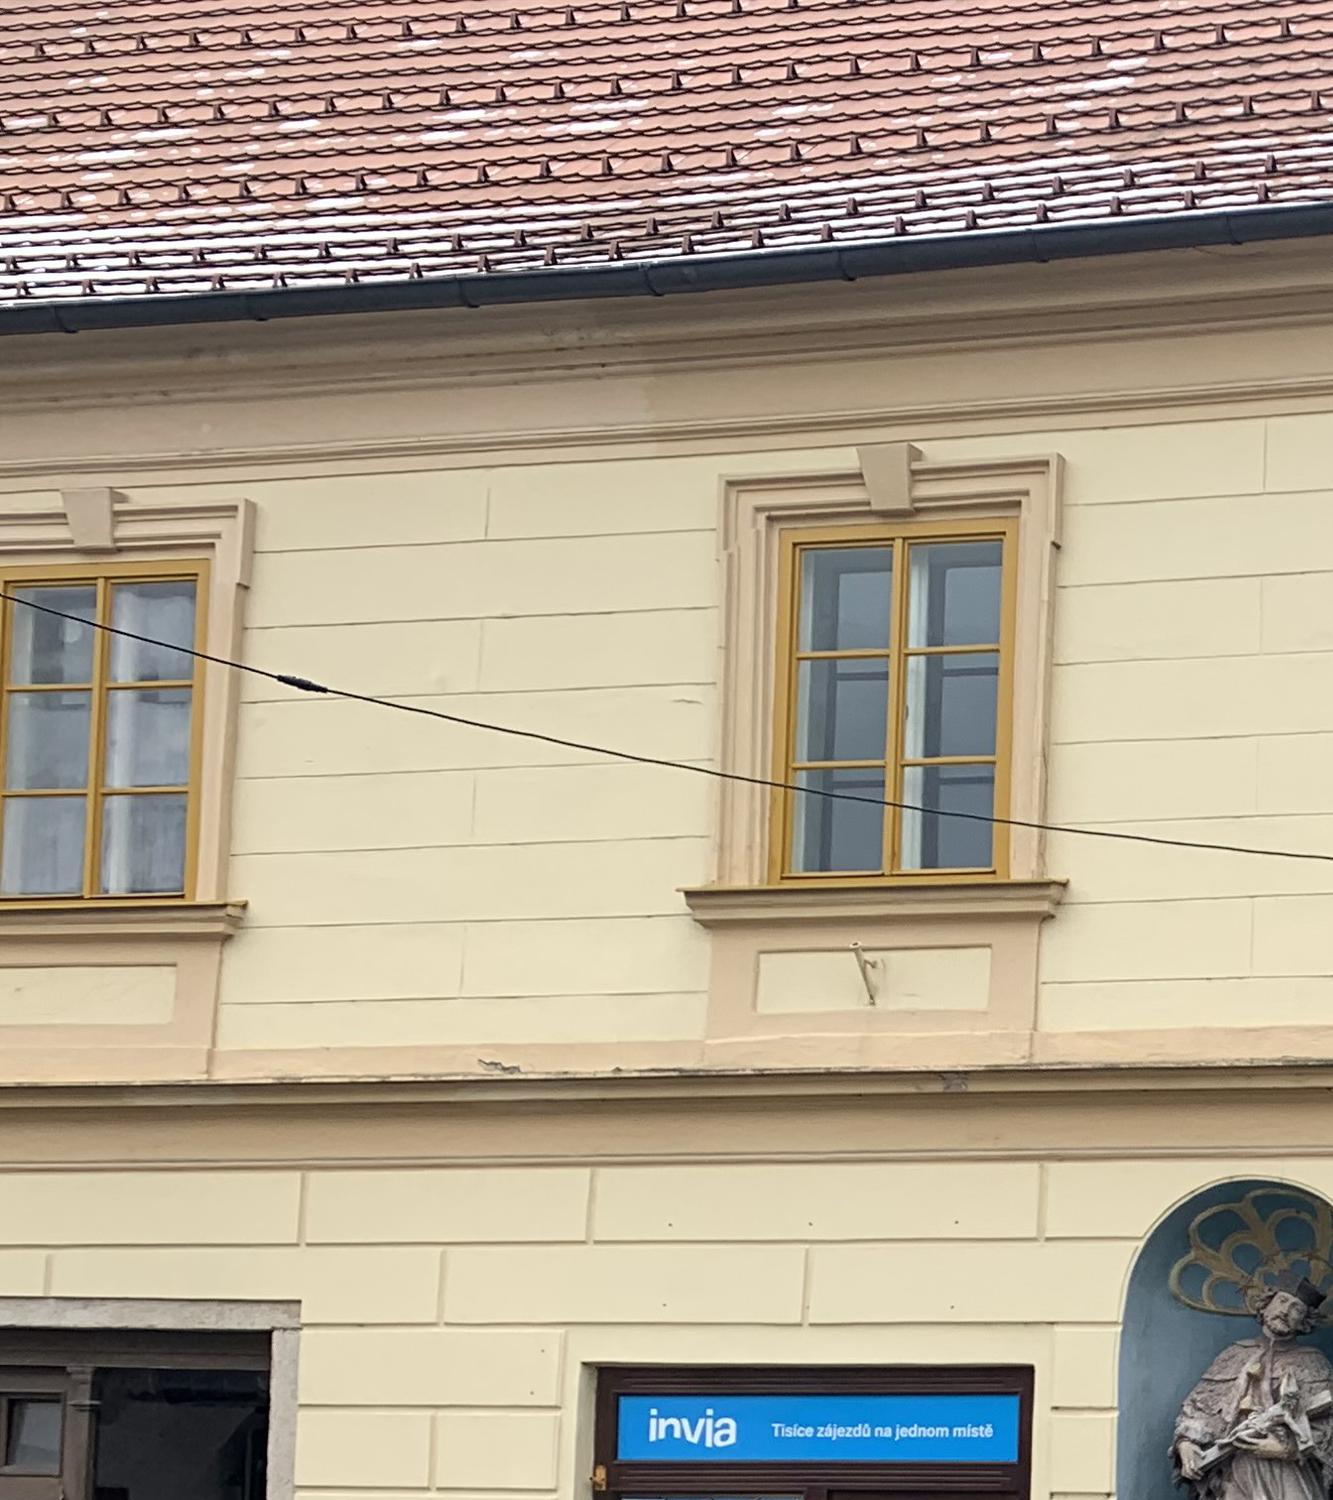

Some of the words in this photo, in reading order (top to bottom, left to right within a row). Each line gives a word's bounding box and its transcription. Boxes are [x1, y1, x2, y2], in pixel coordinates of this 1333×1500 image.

[649, 1408, 737, 1448] invia
[771, 1423, 815, 1438] Tisíce
[816, 1422, 871, 1440] zájezdů
[874, 1426, 893, 1438] na
[894, 1423, 949, 1440] jednom
[953, 1423, 994, 1438] místě
